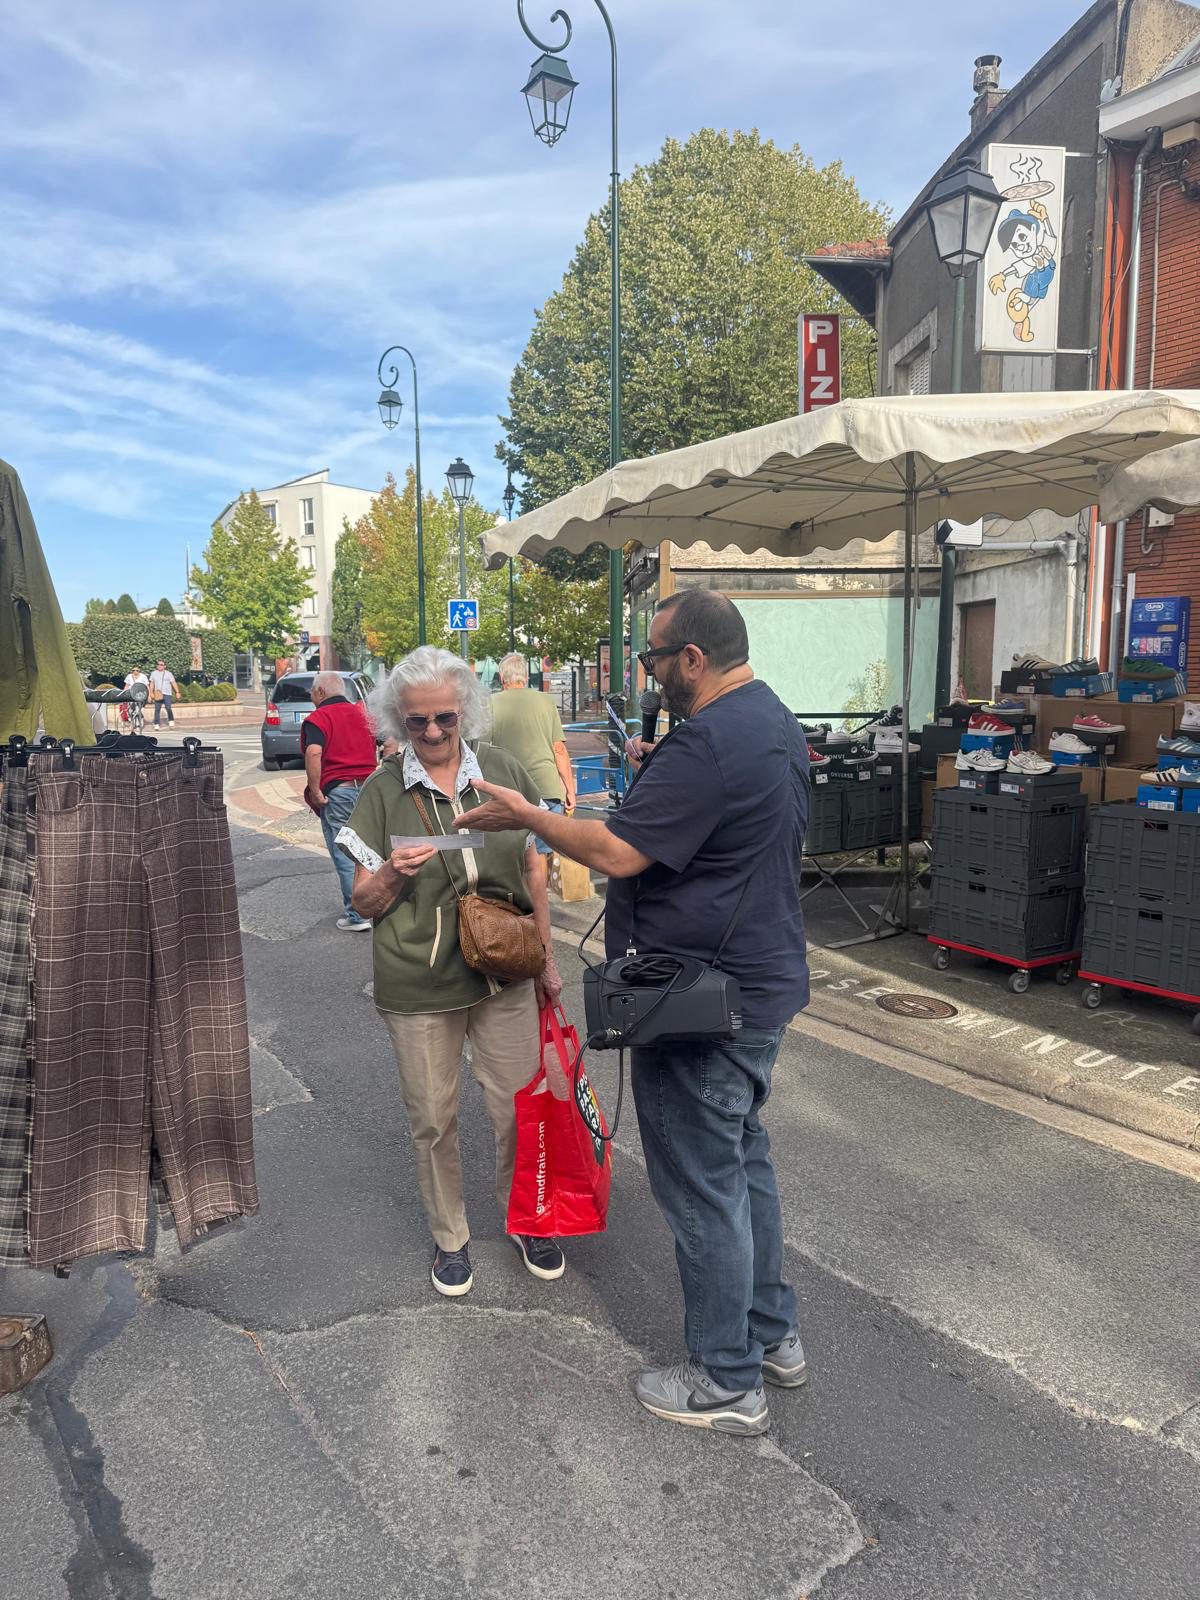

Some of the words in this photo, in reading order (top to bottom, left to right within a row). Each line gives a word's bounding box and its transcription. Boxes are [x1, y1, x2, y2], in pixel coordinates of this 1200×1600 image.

[809, 320, 834, 410] PIZ
[945, 1013, 1200, 1097] MINUTE
[536, 1121, 546, 1214] grandfrais.com
